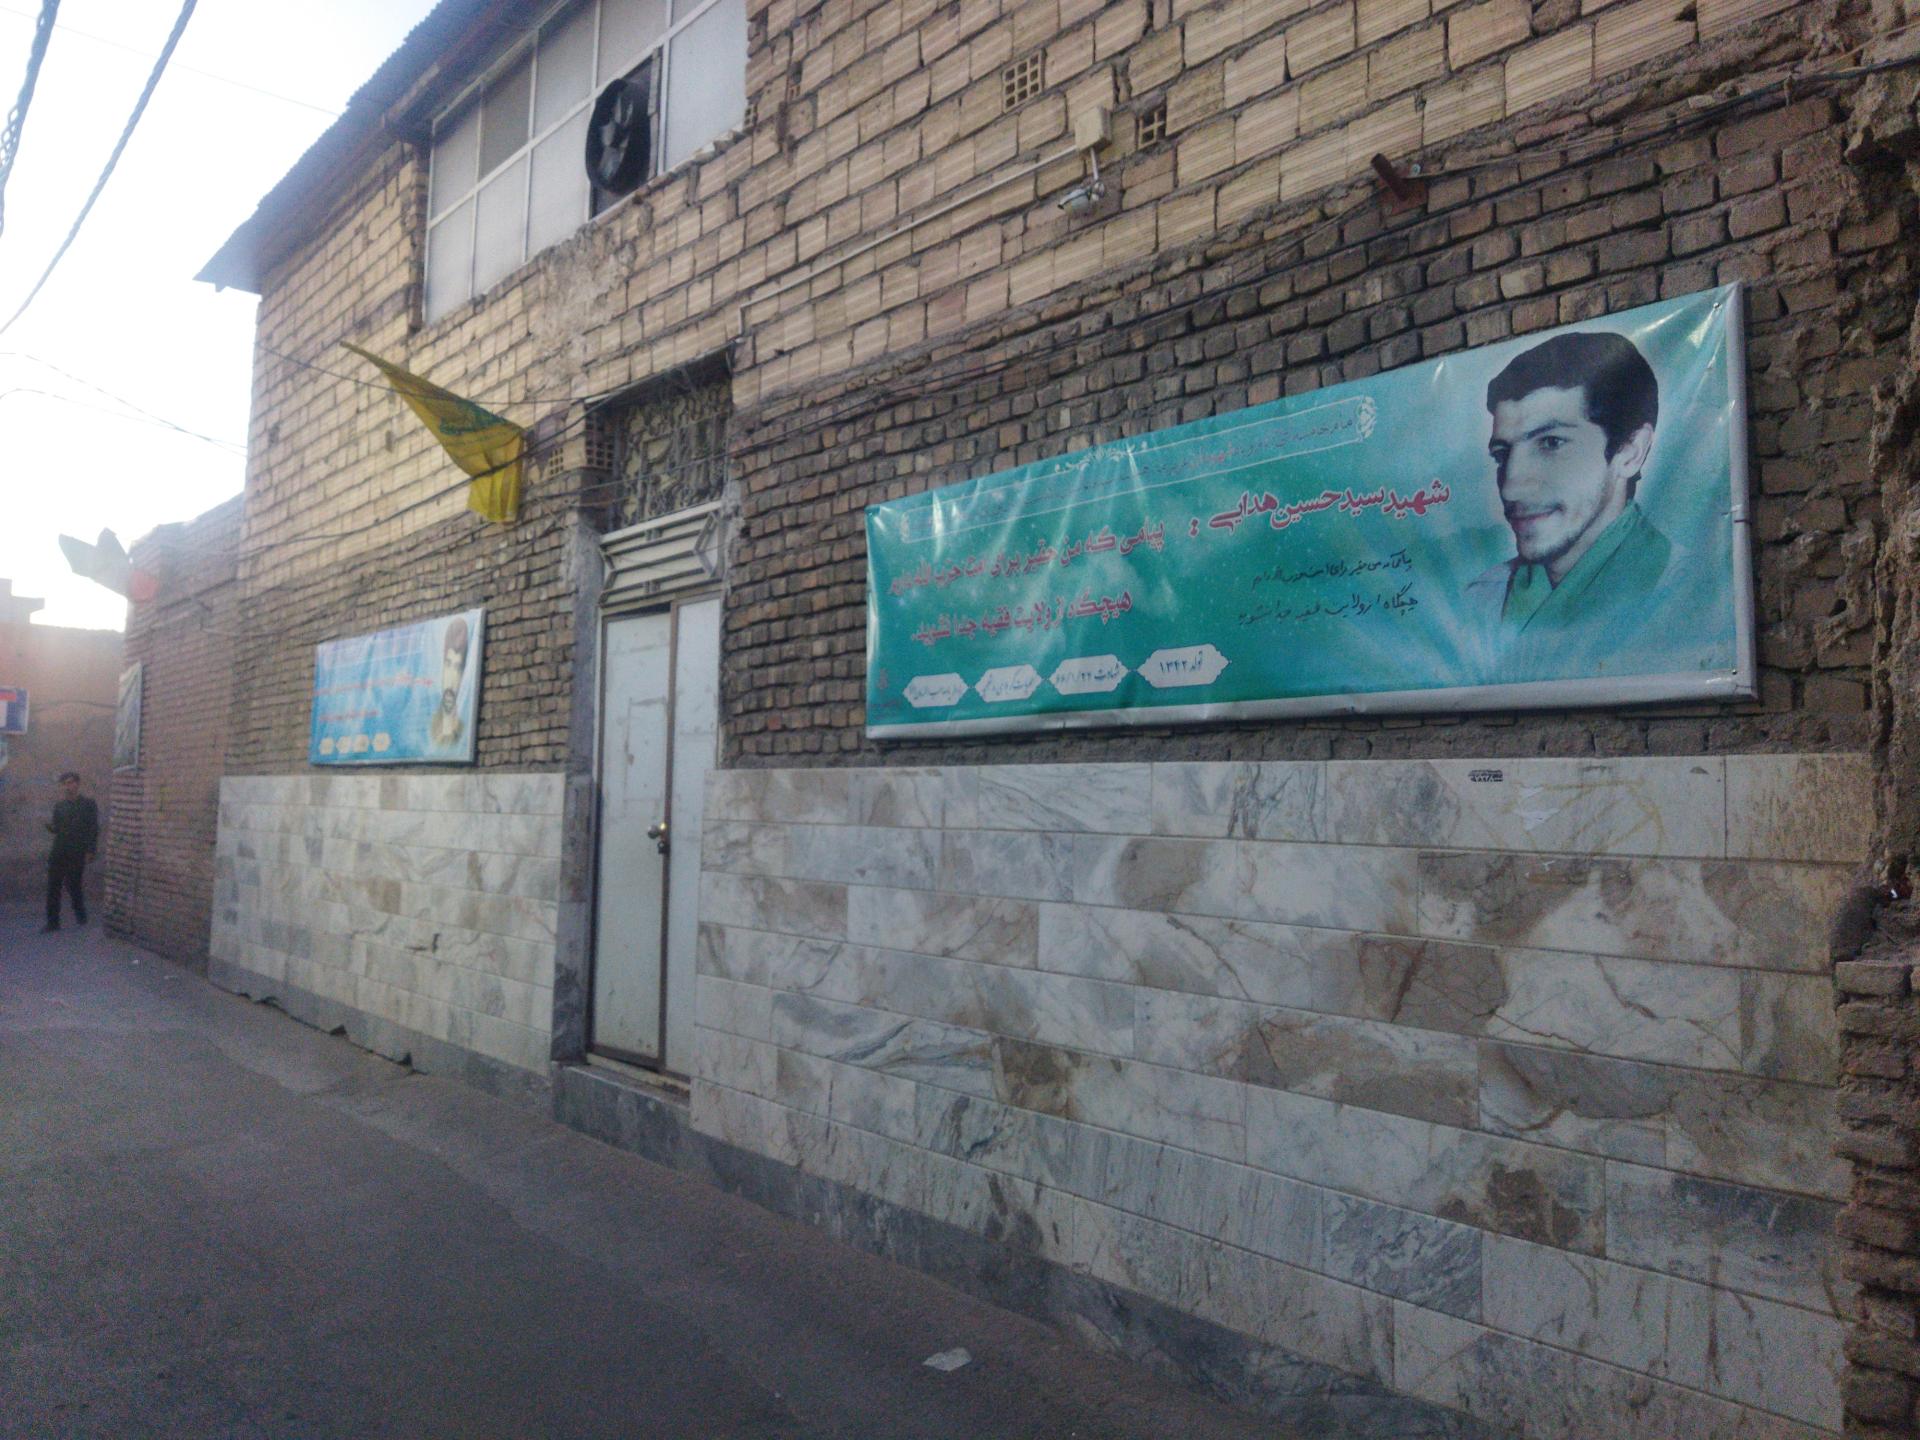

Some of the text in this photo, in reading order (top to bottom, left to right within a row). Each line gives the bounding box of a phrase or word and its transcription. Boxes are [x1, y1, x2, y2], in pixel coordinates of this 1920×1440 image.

[1270, 490, 1342, 529] حسین
[1338, 486, 1385, 516] سید
[1382, 479, 1450, 520] شهید
[1059, 535, 1082, 567] من
[1119, 516, 1166, 554] پیامی
